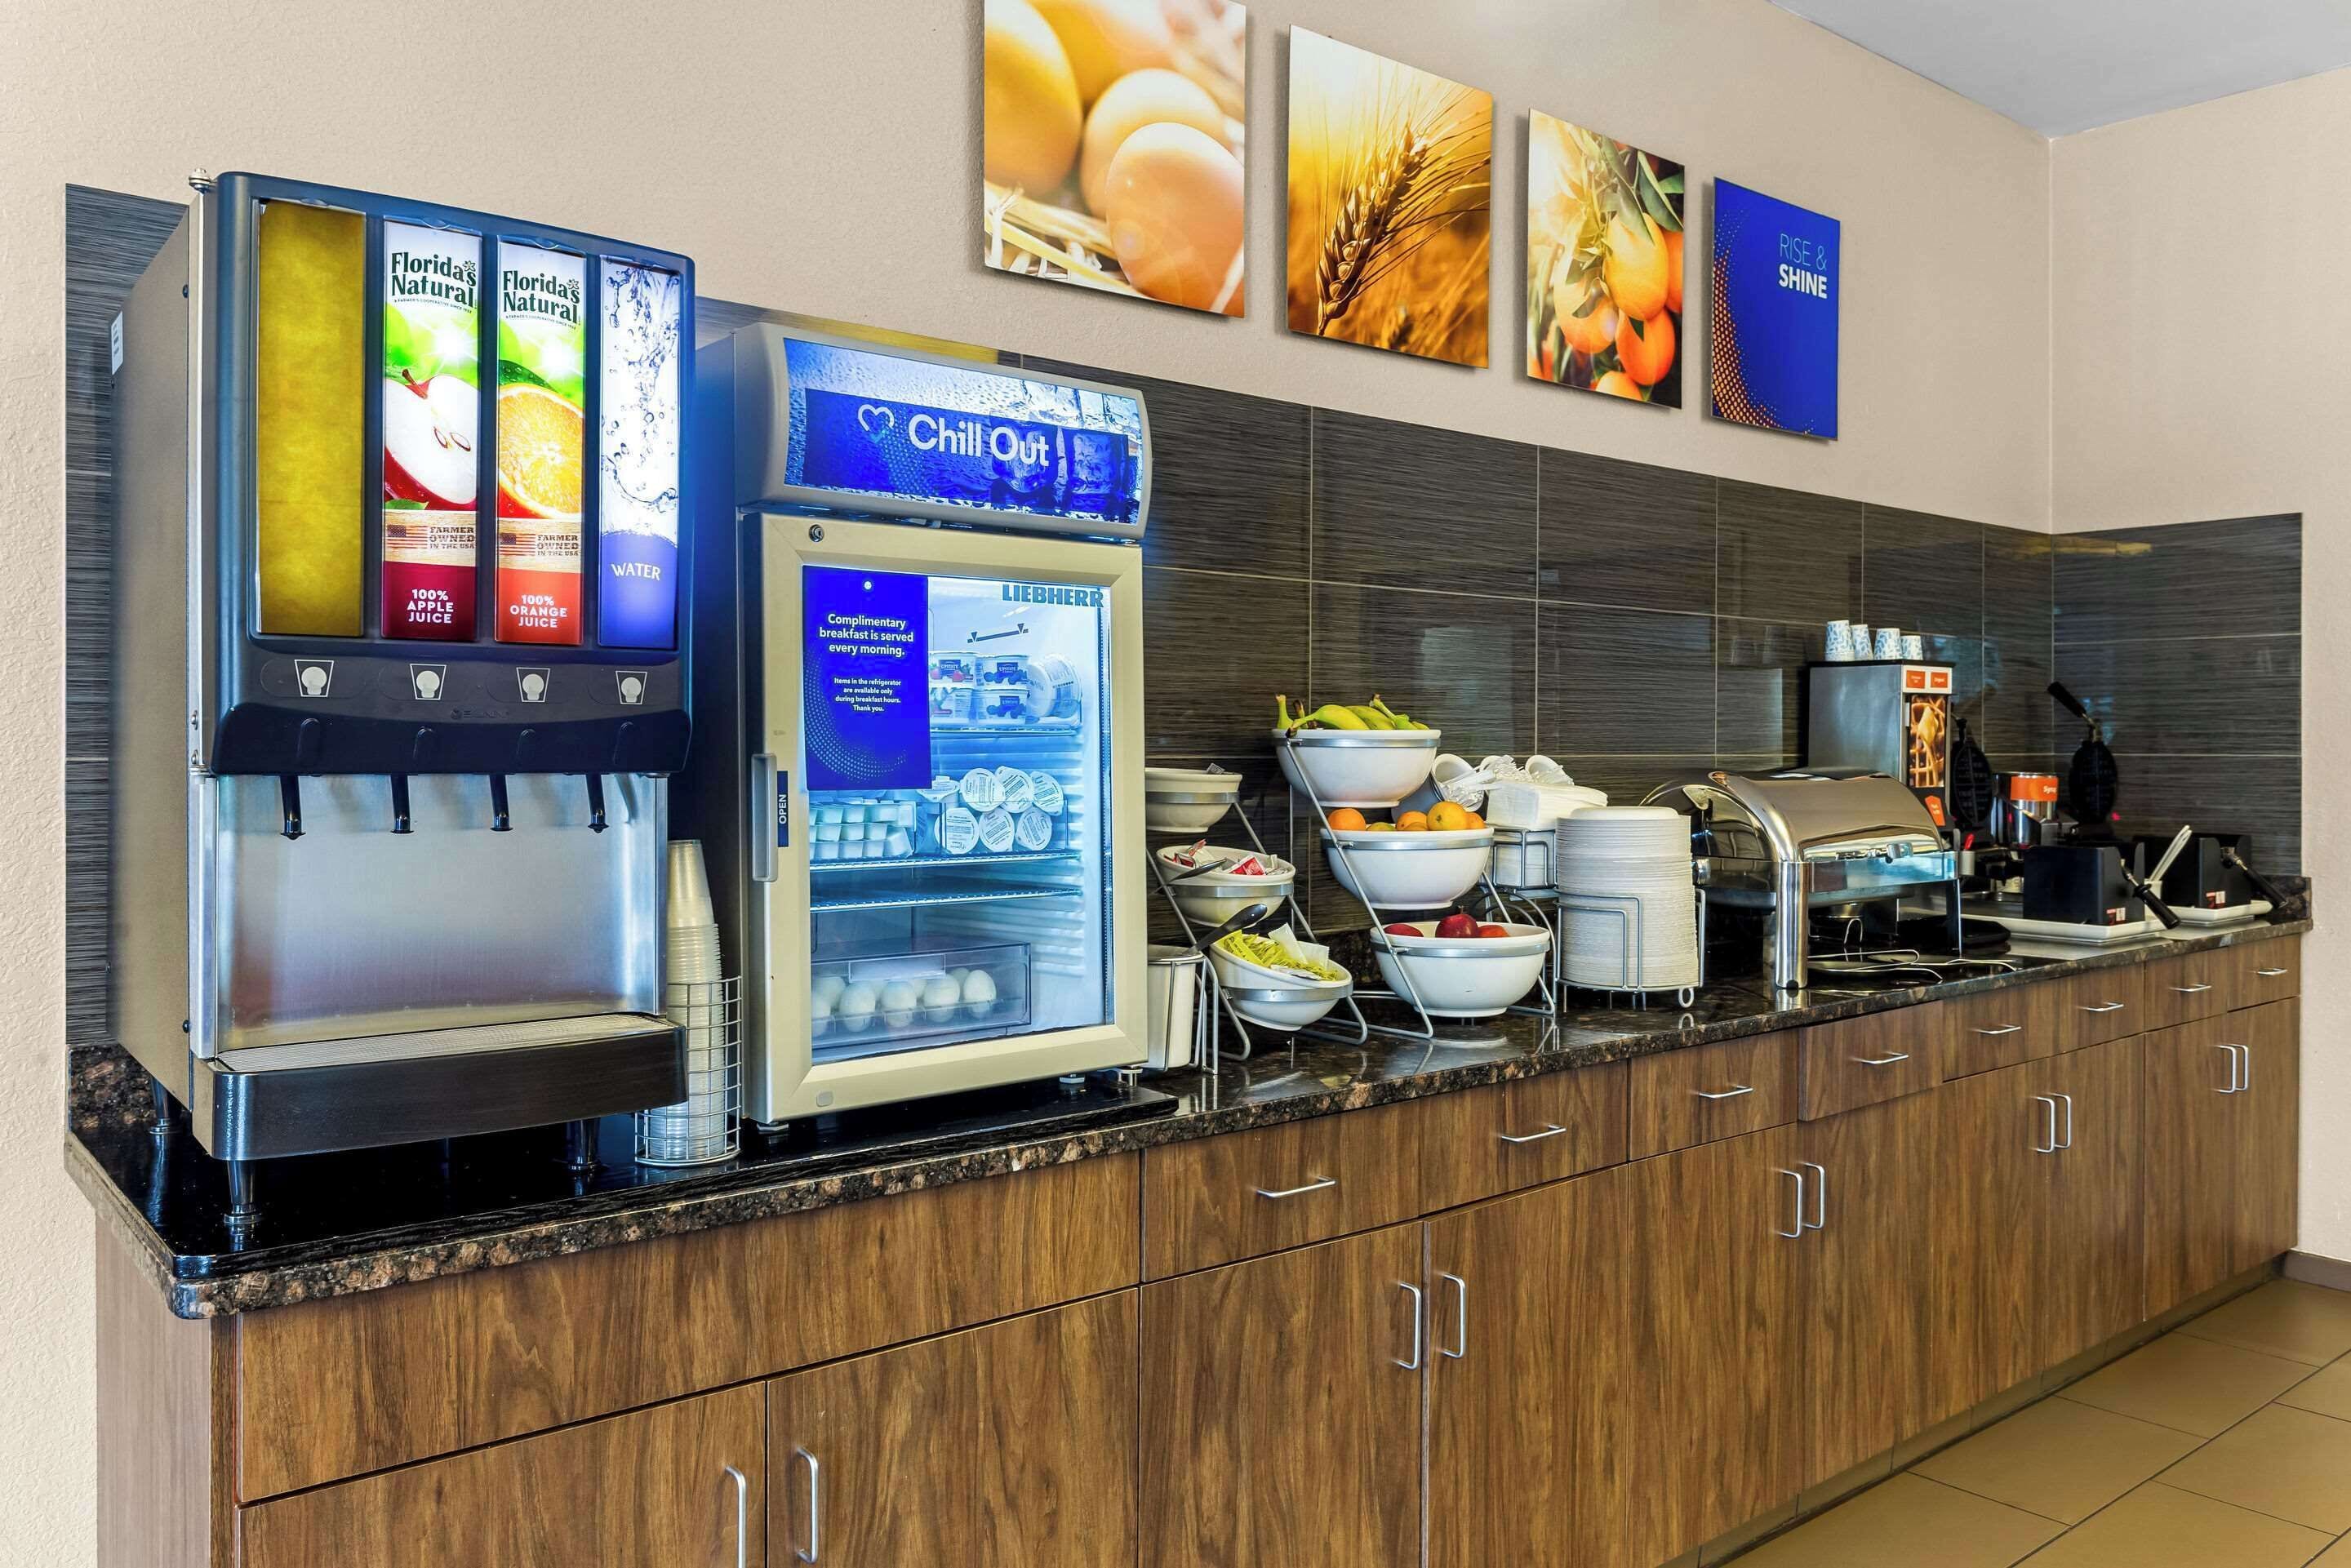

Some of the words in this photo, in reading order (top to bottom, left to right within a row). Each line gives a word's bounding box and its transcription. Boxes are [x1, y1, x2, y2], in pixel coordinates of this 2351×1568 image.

[1780, 233, 1811, 267] RISE
[1816, 245, 1828, 271] &
[1778, 263, 1828, 299] SHINE
[391, 273, 473, 308] Natural
[504, 291, 577, 324] Natural
[908, 413, 981, 457] Chill
[989, 426, 1050, 467] Out
[611, 562, 660, 580] WATER
[412, 589, 449, 601] 100%
[522, 594, 554, 606] 100%
[1002, 584, 1104, 607] LIEBHERR
[407, 600, 454, 612] APPLE
[509, 605, 567, 617] ORANGE
[408, 612, 451, 624] JUICE
[518, 616, 558, 628] JUICE
[828, 614, 906, 630] Complimentary
[819, 626, 869, 640] breakfast
[870, 629, 881, 640] is
[881, 632, 913, 642] served
[829, 644, 858, 655] every
[860, 645, 905, 657] morning.
[869, 678, 901, 686] refrigerator
[779, 794, 787, 824] OPEN
